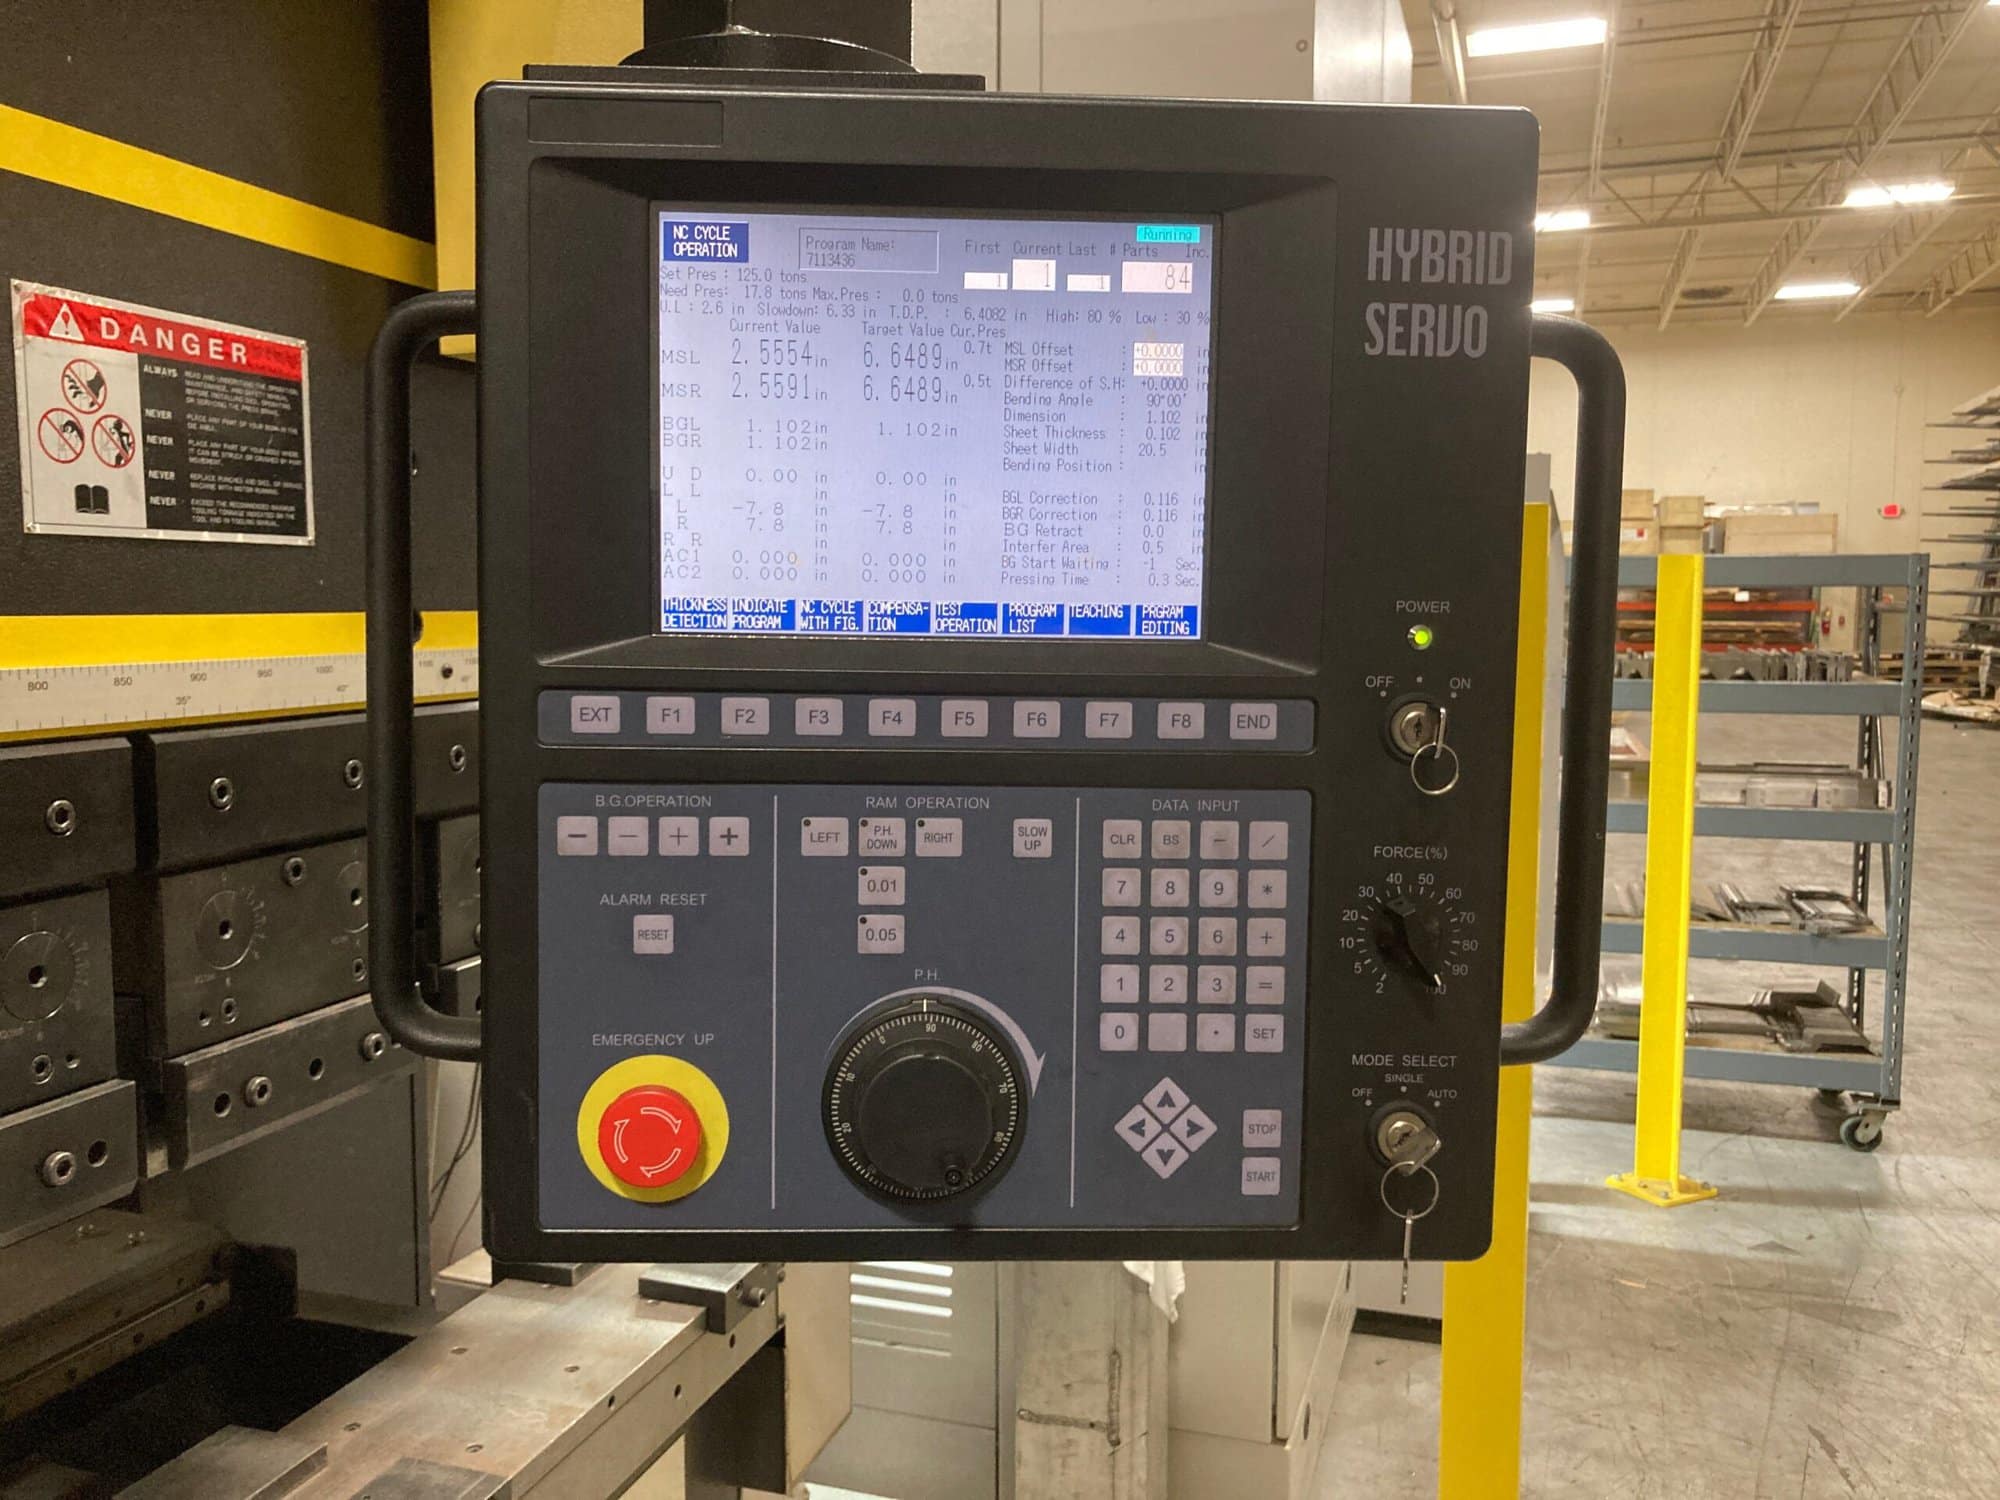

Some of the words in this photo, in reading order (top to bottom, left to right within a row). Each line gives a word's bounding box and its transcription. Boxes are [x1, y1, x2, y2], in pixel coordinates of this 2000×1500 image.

[673, 225, 689, 240] NC
[694, 226, 731, 241] CYCLE
[1143, 227, 1192, 243] Running
[673, 242, 738, 258] OPERATION
[806, 235, 856, 251] Program
[861, 237, 895, 252] Name:
[964, 240, 1001, 254] First
[1013, 242, 1062, 256] Current
[1068, 242, 1096, 257] Last
[1122, 244, 1158, 258] Parts
[1368, 227, 1512, 285] HYBRID
[1164, 264, 1190, 290] 84
[729, 318, 779, 333] Current
[785, 320, 821, 335] Value
[862, 321, 904, 337] Target
[909, 322, 945, 337] Value
[1364, 302, 1488, 359] SERVO
[100, 316, 249, 365] DANGER
[144, 364, 178, 378] ALWAYS
[145, 408, 173, 419] NEVER
[146, 434, 174, 445] NEVER
[148, 469, 176, 480] NEVER
[150, 496, 177, 506] NEVER
[664, 598, 726, 613] THICKNESS
[733, 599, 788, 614] INDICATE
[800, 599, 816, 614] NC
[821, 600, 856, 615] CYCLE
[868, 601, 929, 615] COMPENSA-
[936, 602, 963, 616] TEST
[1009, 603, 1056, 618] PROGRAM
[1071, 604, 1123, 618] TEACHING
[1142, 605, 1183, 619] PRGRAM
[1396, 601, 1450, 613] POWER
[664, 614, 727, 629] DETECTION
[733, 615, 782, 629] PROGRAM
[800, 616, 829, 630] WITH
[835, 616, 859, 631] FIG.
[869, 617, 897, 632] TION
[936, 618, 997, 633] OPERATION
[1010, 619, 1037, 633] LIST
[1142, 620, 1189, 635] EDITING
[27, 680, 49, 691] 800
[113, 676, 133, 686] 850
[190, 672, 207, 682] 900
[1365, 675, 1395, 688] OFF
[1449, 677, 1471, 689] ON
[579, 707, 612, 722] EXT
[661, 708, 681, 723] F1
[734, 709, 755, 724] F2
[808, 710, 829, 725] F3
[882, 710, 903, 725] F4
[954, 711, 975, 727] F5
[1027, 712, 1047, 727] F6
[1099, 713, 1120, 728] F7
[1171, 713, 1192, 729] F8
[1236, 714, 1270, 730] END
[595, 795, 712, 808] B.G.OPERATION
[865, 797, 897, 809] RAM
[905, 797, 990, 809] OPERATION
[1152, 800, 1189, 811] DATA
[1198, 800, 1240, 812] INPUT
[810, 832, 840, 844] LEFT
[924, 832, 954, 844] RIGHT
[1017, 826, 1047, 838] SLOW
[1110, 833, 1135, 845] CLR
[867, 838, 897, 850] DOWN
[1024, 839, 1041, 850] UP
[1163, 834, 1180, 846] BS
[1373, 845, 1449, 861] FORCE(%)
[1386, 873, 1403, 885] 40
[1418, 873, 1435, 885] 50
[867, 880, 897, 893] 0.01
[1116, 881, 1127, 895] 7
[1165, 882, 1175, 895] 8
[1213, 882, 1224, 895] 9
[1358, 886, 1375, 898] 30
[1445, 887, 1462, 899] 60
[600, 894, 651, 906] ALARM
[660, 894, 707, 906] RESET
[1342, 910, 1359, 922] 20
[1459, 912, 1476, 924] 70
[638, 929, 669, 941] RESET
[865, 928, 897, 942] 0.05
[1115, 929, 1126, 942] 4
[1164, 929, 1175, 943] 5
[1212, 930, 1223, 943] 6
[1339, 937, 1355, 949] 10
[1462, 939, 1479, 951] 80
[1354, 962, 1363, 974] 5
[1452, 964, 1469, 976] 90
[1116, 978, 1124, 991] 1
[1163, 978, 1174, 992] 2
[1212, 978, 1222, 992] 3
[1376, 982, 1385, 993] 2
[1114, 1026, 1125, 1039] 0
[1252, 1028, 1276, 1040] SET
[592, 1034, 685, 1047] EMERGENCY
[694, 1034, 715, 1046] UP
[1352, 1054, 1394, 1067] MODE
[1402, 1055, 1457, 1068] SELECT
[1384, 1073, 1424, 1083] SINGLE
[1352, 1087, 1373, 1098] OFF
[1427, 1088, 1458, 1099] AUTO
[1248, 1123, 1277, 1135] STOP
[1246, 1171, 1276, 1183] START
